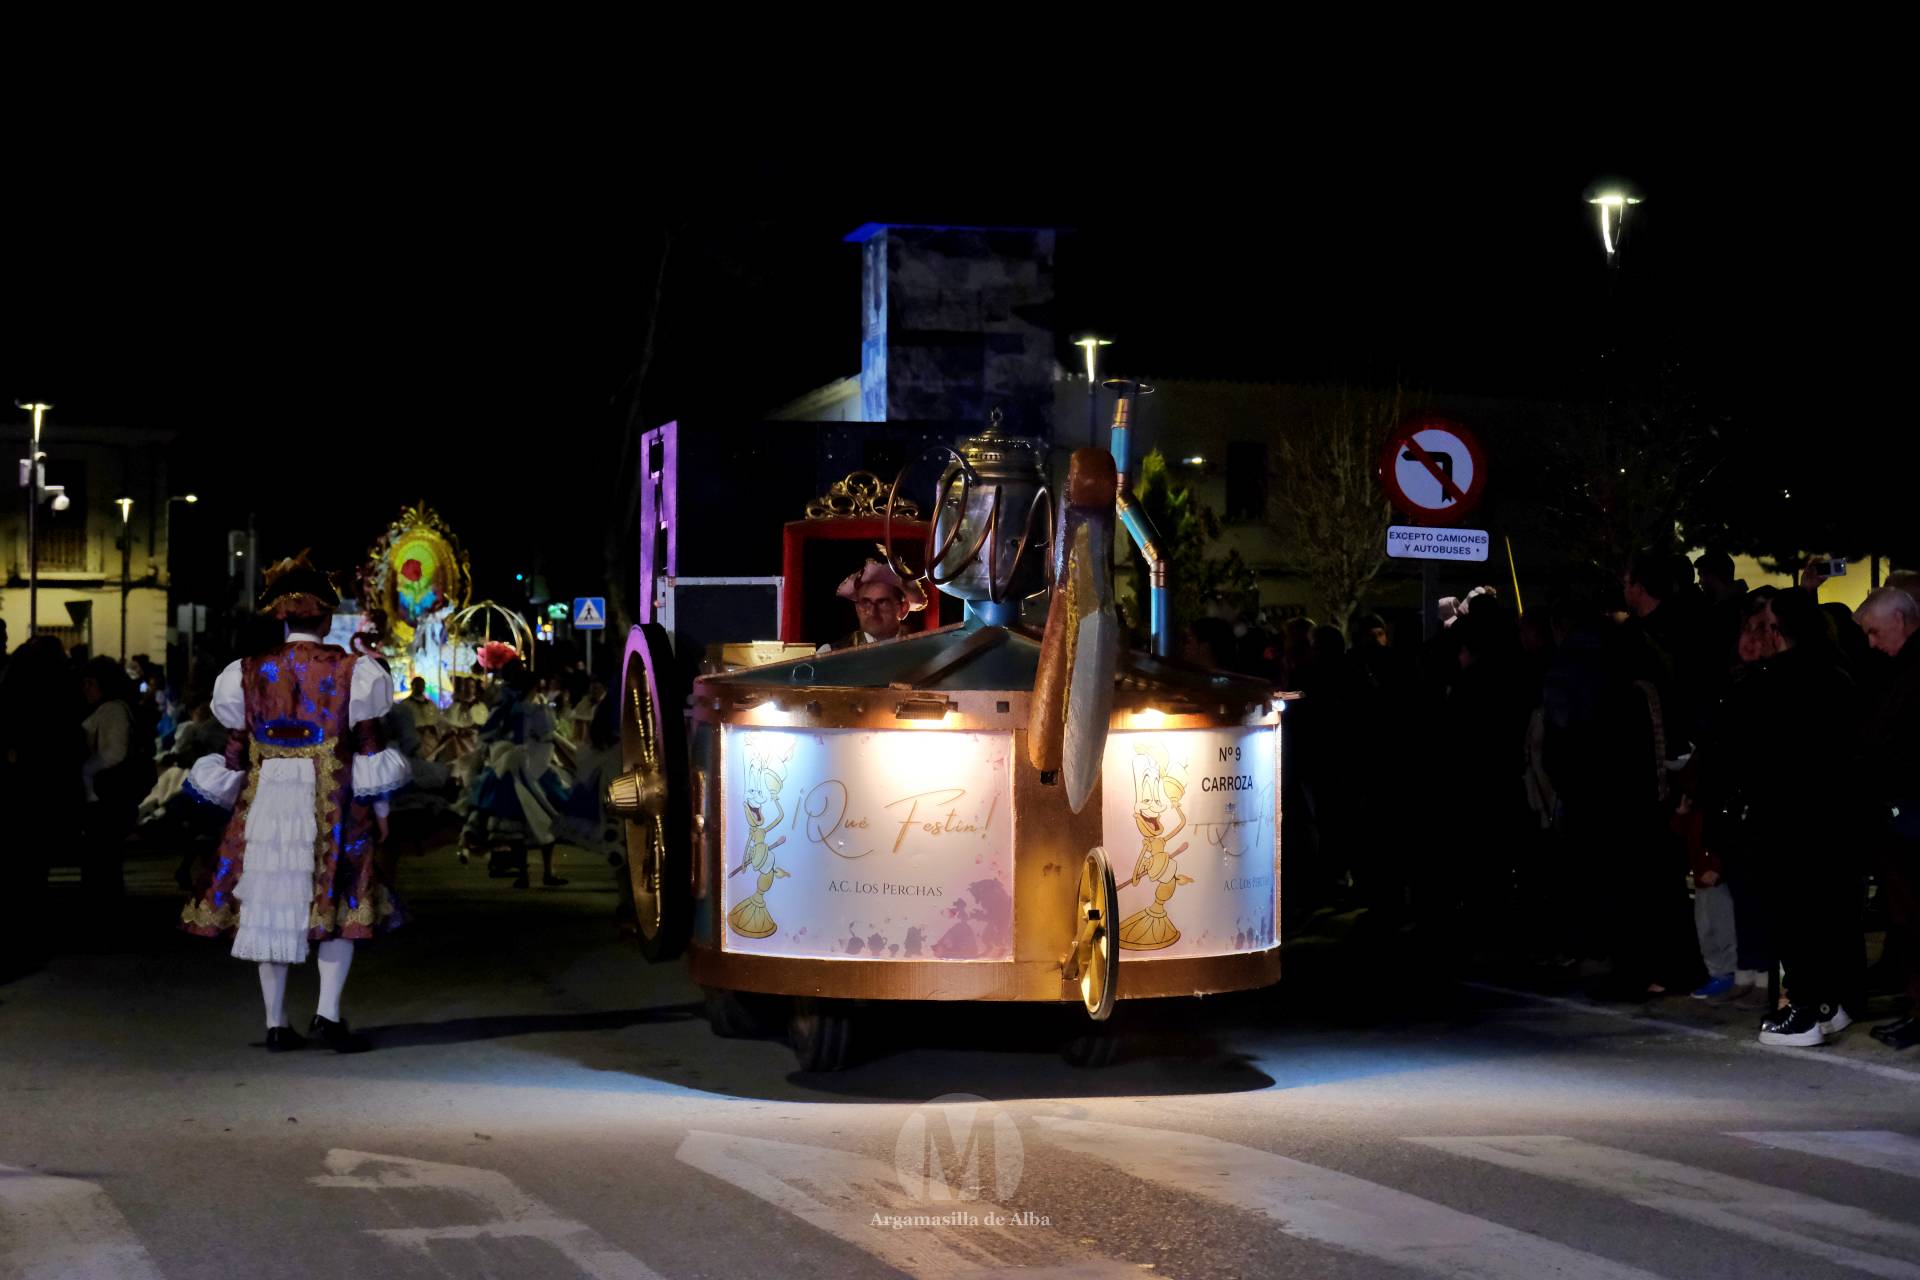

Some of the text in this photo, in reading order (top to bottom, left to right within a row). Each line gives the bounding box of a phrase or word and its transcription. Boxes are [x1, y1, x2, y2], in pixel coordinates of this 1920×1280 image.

[1389, 531, 1487, 544] EXCEPTO CAMIONES
[1404, 543, 1471, 555] Y AUTOBUSES
[1235, 746, 1242, 762] 9
[1201, 775, 1254, 793] CARROZA
[828, 880, 944, 897] A.C. LOS PERCHAS
